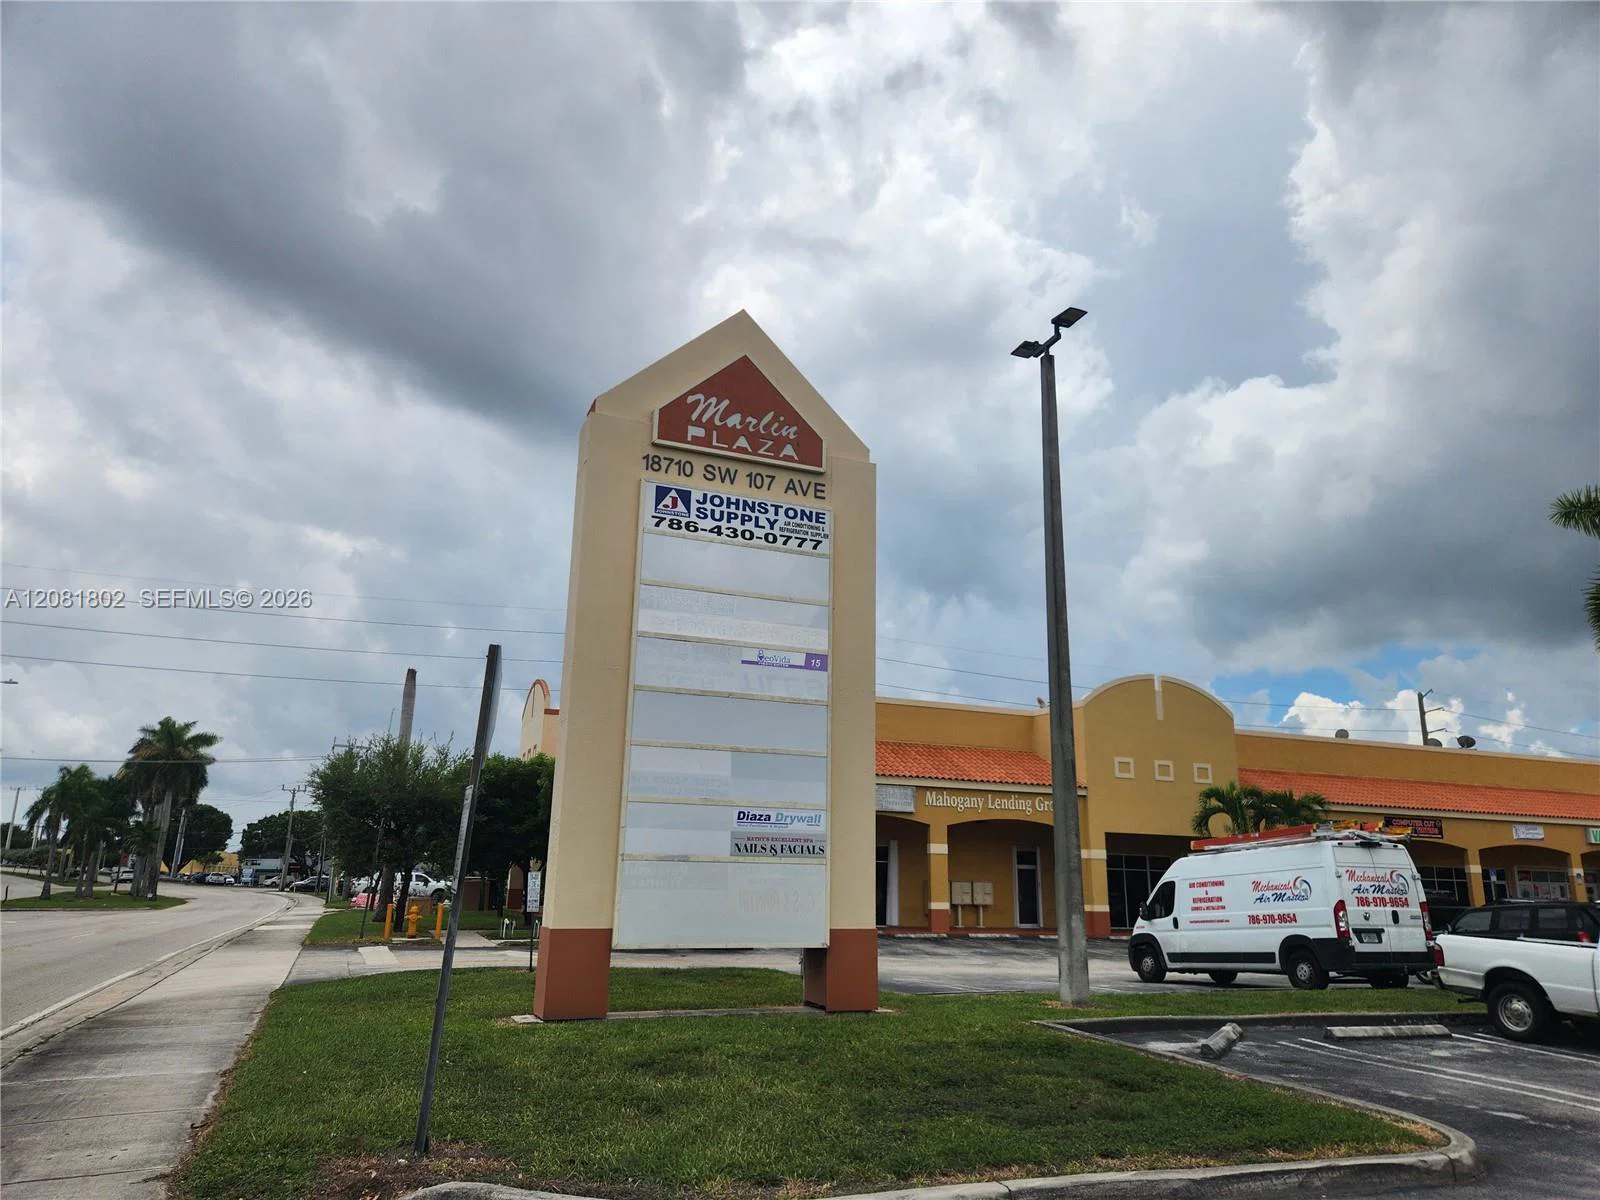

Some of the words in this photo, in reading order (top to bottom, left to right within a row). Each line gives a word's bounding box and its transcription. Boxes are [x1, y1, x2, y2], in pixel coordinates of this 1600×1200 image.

[687, 393, 798, 440] Marlin
[687, 425, 799, 461] PLAZA
[642, 453, 694, 478] 18710
[703, 464, 738, 485] SW
[746, 471, 776, 491] 107
[784, 478, 826, 500] AVE
[655, 508, 689, 518] JOHNSTONE
[695, 493, 826, 525] JOHNSTONE
[695, 506, 779, 531] SUPPLY
[651, 515, 823, 550] 786-430-0777
[779, 526, 809, 536] REFRIGERATION
[810, 531, 829, 540] SUPPLIER
[792, 522, 821, 532] CONDITIONING
[810, 659, 821, 667] 15
[925, 791, 984, 813] Mahogany
[988, 794, 1032, 815] Lending
[737, 811, 771, 822] Diaza
[774, 812, 821, 825] Drywall
[734, 843, 766, 853] NAILS
[769, 843, 778, 856] &
[780, 844, 825, 855] FACIALS
[1345, 869, 1390, 883] Mechanical
[1196, 880, 1225, 888] CONDITIONING
[1251, 880, 1292, 892] Mechanical
[1351, 884, 1369, 895] Air
[1370, 884, 1408, 896] Masters
[1253, 892, 1271, 904] Air
[1271, 892, 1309, 902] Masters
[1355, 896, 1409, 908] 786-970-9654
[1247, 913, 1298, 925] 786-970-9654
